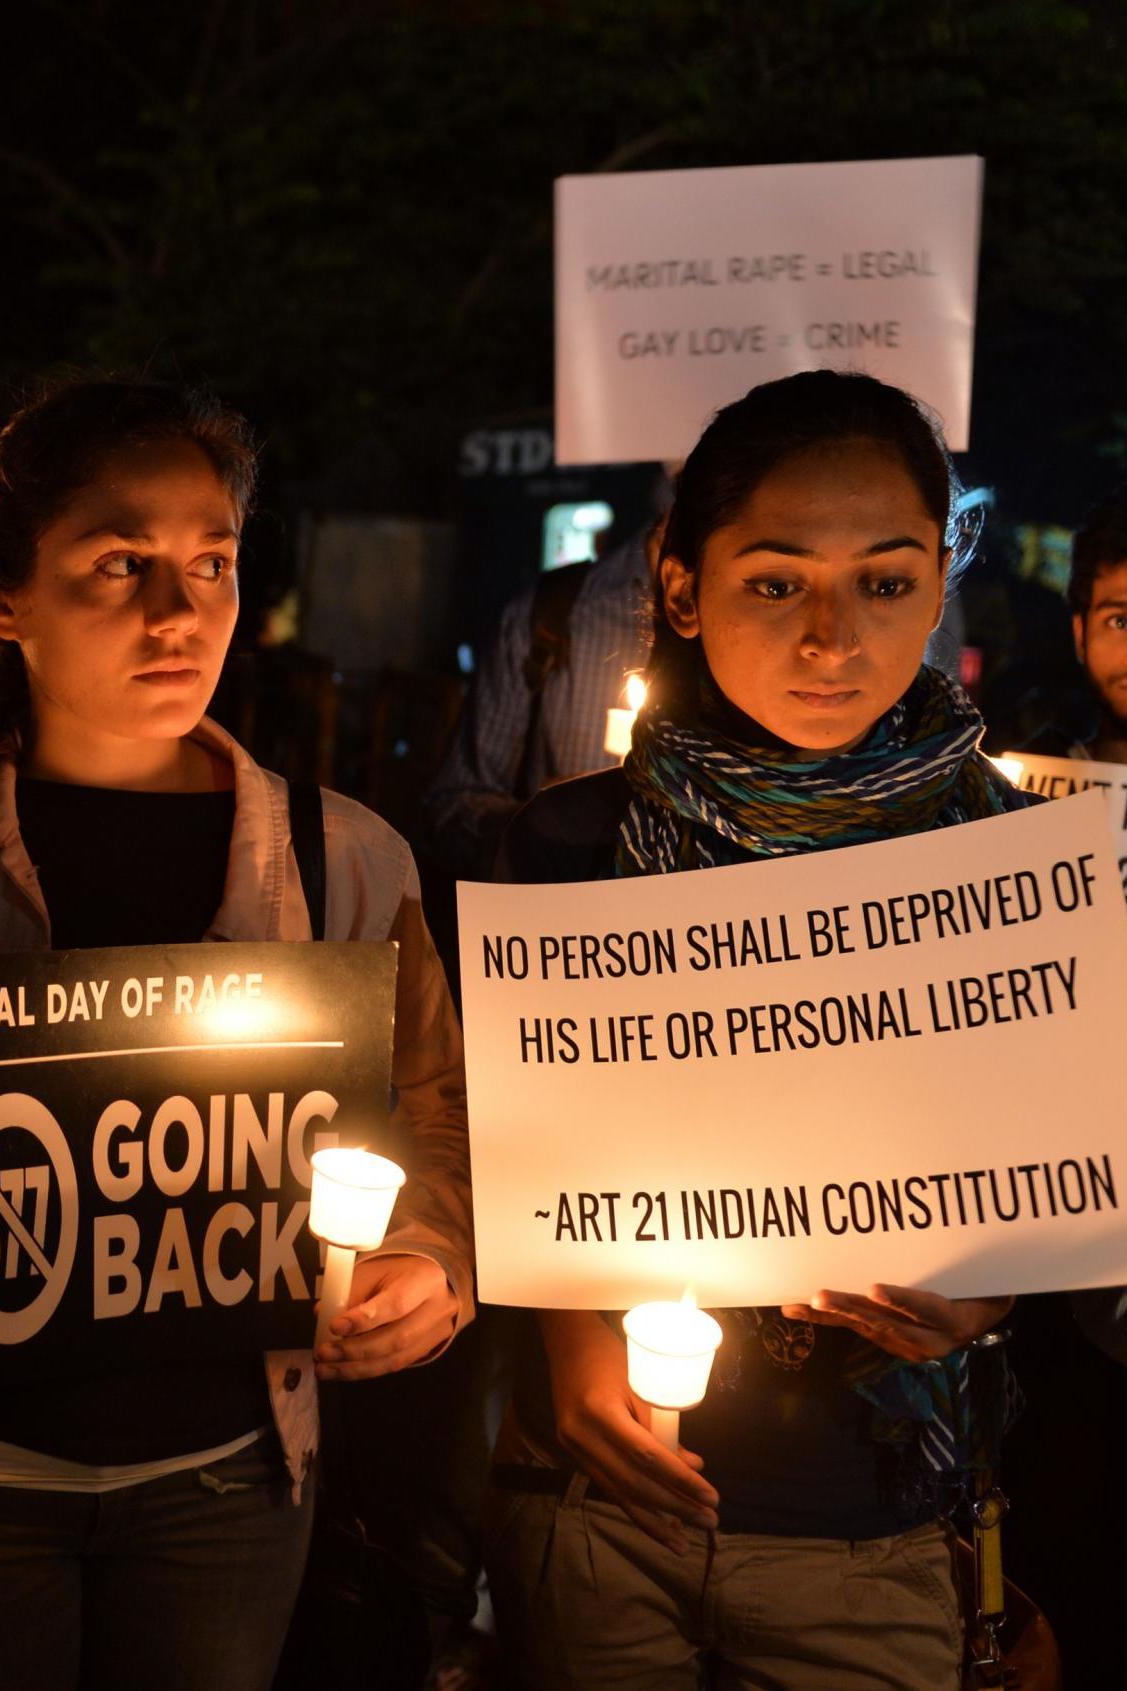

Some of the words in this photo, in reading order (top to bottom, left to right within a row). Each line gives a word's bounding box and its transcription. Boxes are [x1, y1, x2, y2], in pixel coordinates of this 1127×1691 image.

[585, 261, 718, 291] MARITAL
[728, 253, 806, 283] RAPE
[842, 250, 937, 281] LEGAL
[618, 331, 679, 360] GAY
[689, 326, 766, 357] LOVE
[805, 321, 900, 351] CRIME
[482, 934, 529, 980] NO
[540, 928, 677, 980] PERSON
[686, 914, 801, 971] SHALL
[807, 905, 851, 957] BE
[862, 870, 1042, 950] DEPRIVED
[1051, 853, 1096, 913] OF
[47, 980, 109, 1024] DAY
[121, 977, 164, 1018] OF
[175, 973, 263, 1016] RAGE
[519, 1017, 580, 1064] HIS
[589, 1015, 658, 1063] LIFE
[666, 1011, 716, 1060] OR
[726, 987, 922, 1056] PERSONAL
[927, 956, 1079, 1033] LIBERTY
[92, 1090, 339, 1203] GOING
[632, 1191, 670, 1242] 21
[681, 1185, 812, 1240] INDIAN
[822, 1154, 1119, 1235] CONSTITUTION
[92, 1201, 327, 1320] BACK
